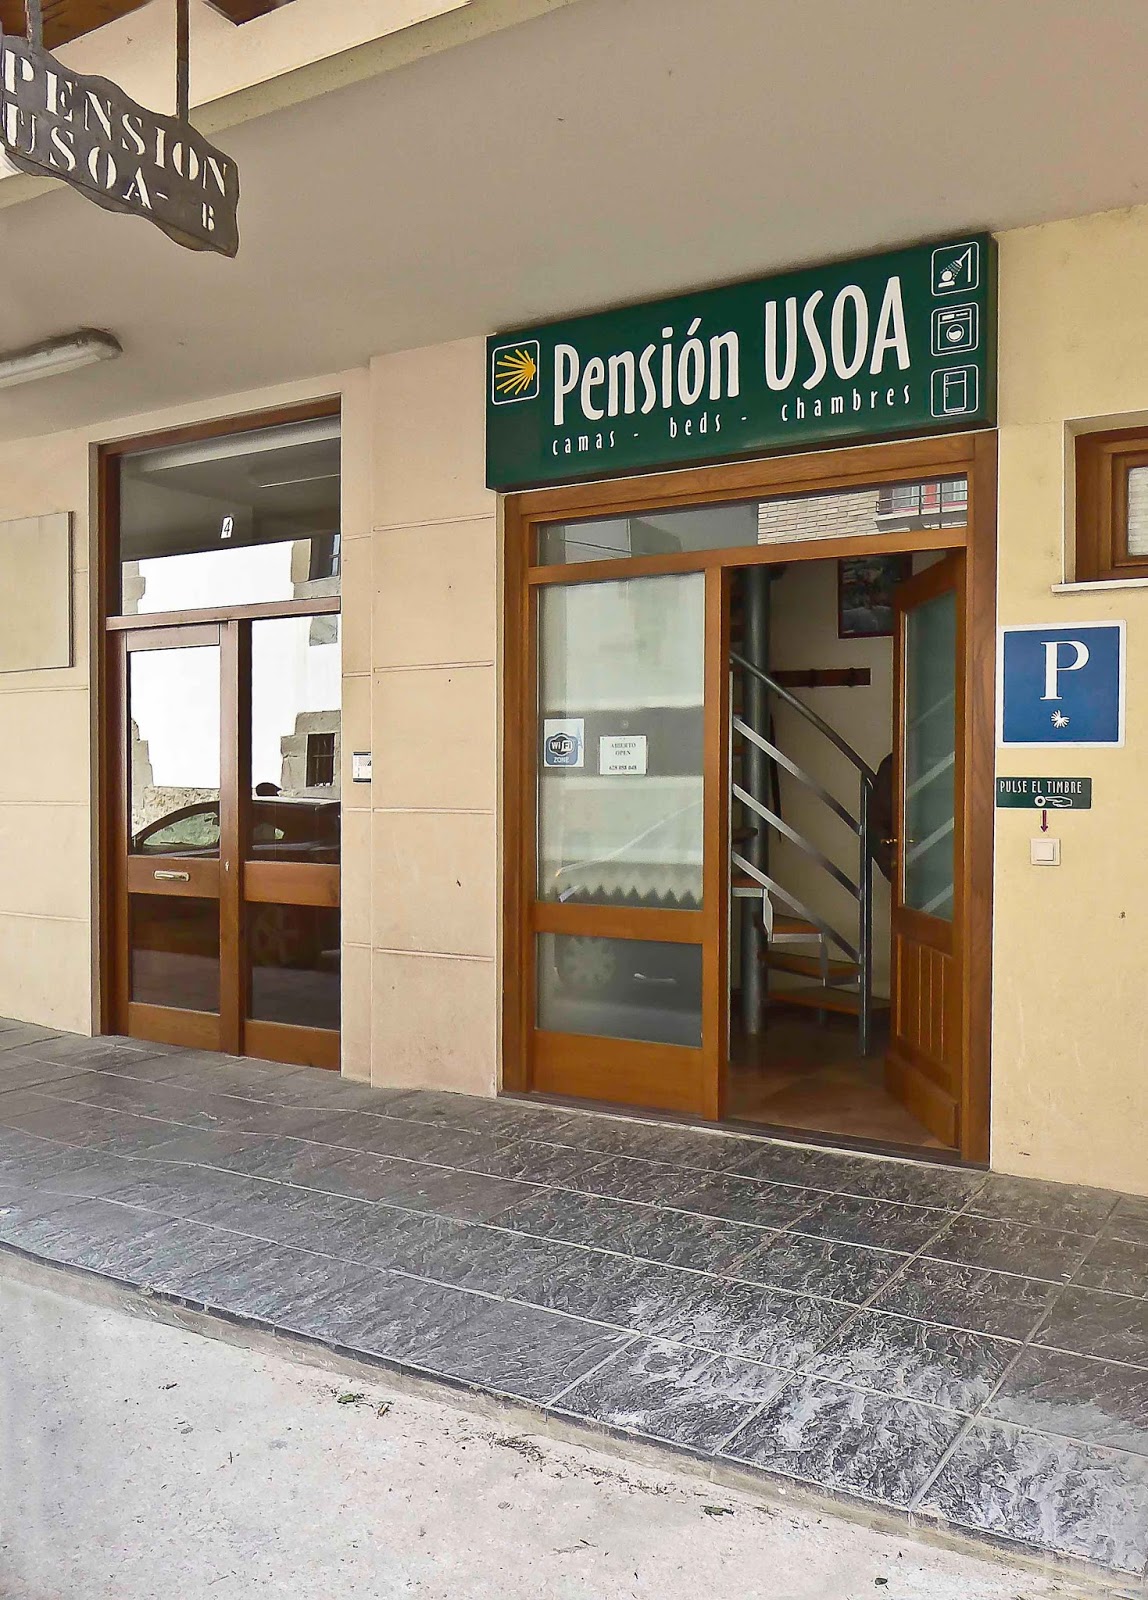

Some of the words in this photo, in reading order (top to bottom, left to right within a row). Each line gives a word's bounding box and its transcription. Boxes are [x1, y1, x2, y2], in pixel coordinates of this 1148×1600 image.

[5, 49, 228, 197] PENSION
[553, 317, 740, 426] Pensión
[765, 276, 911, 391] USOA
[552, 431, 615, 456] camas
[669, 412, 721, 438] beds
[781, 385, 910, 422] chambres
[224, 519, 231, 536] 4
[1039, 640, 1090, 700] P
[1000, 780, 1028, 794] PULSE
[1031, 780, 1043, 793] EL
[1046, 780, 1082, 794] TIMBRE
